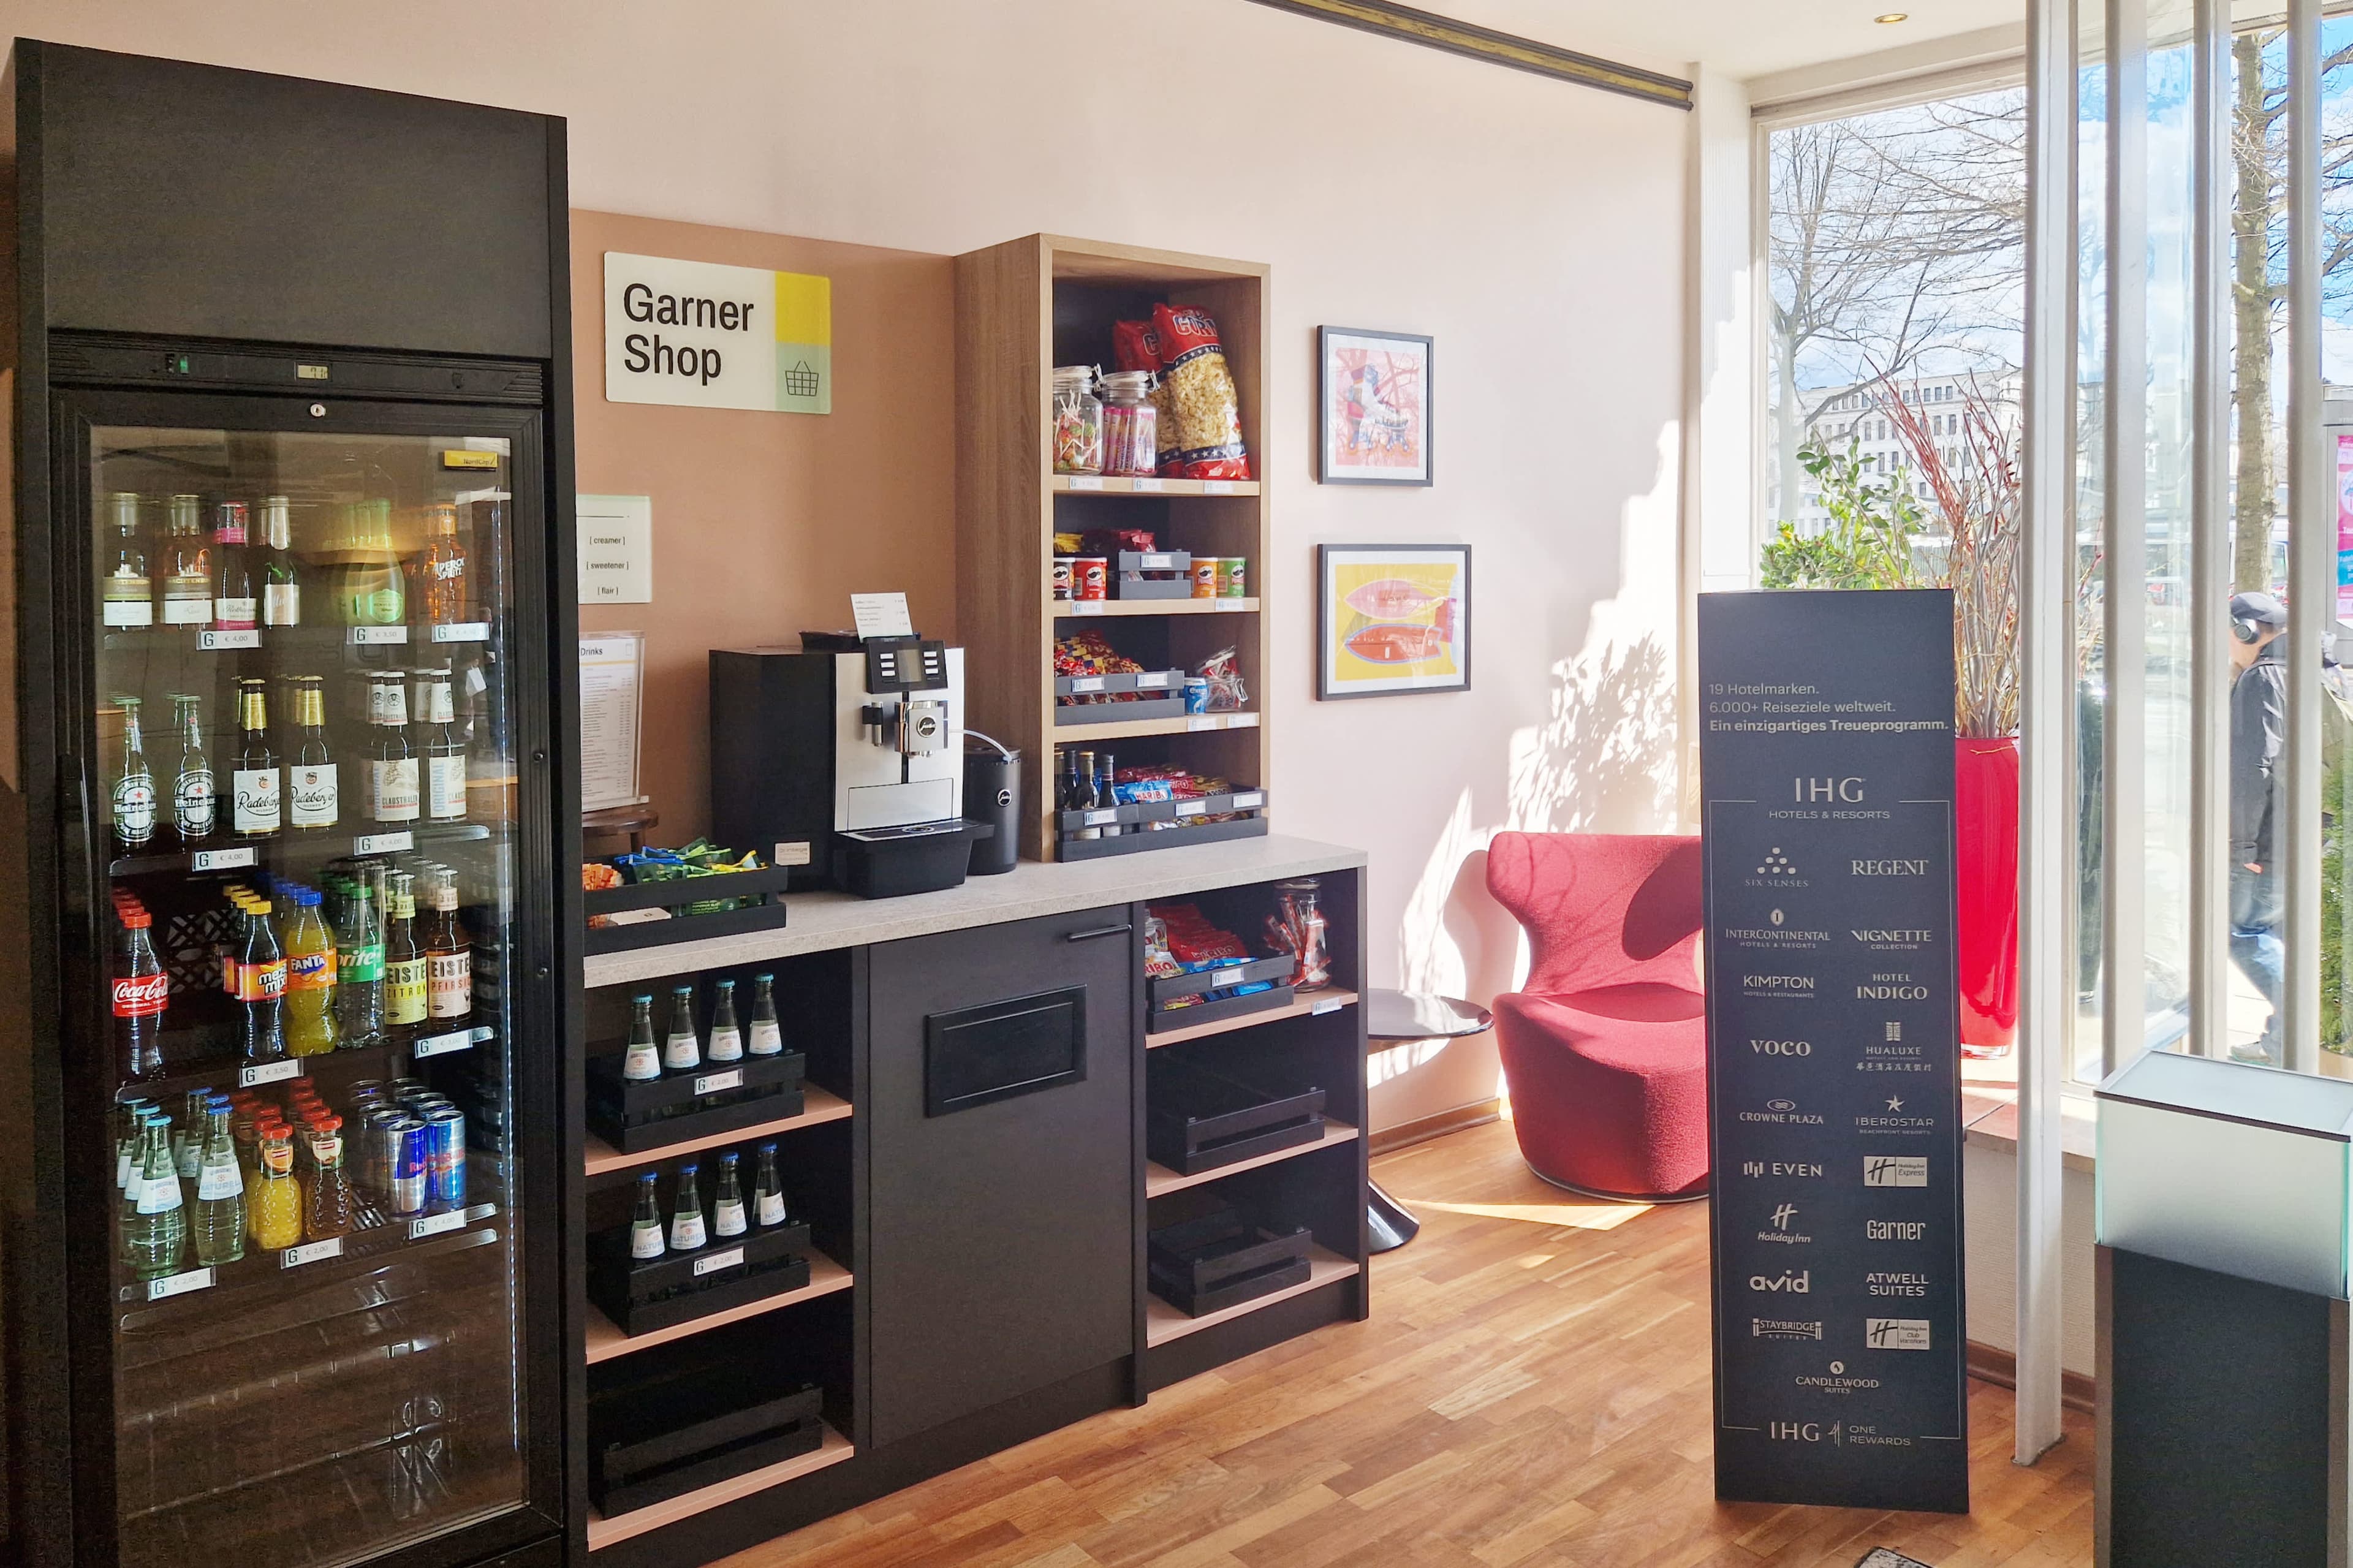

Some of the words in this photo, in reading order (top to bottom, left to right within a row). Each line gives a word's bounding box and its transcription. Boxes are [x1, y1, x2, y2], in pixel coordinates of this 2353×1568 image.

[624, 283, 754, 331] Garner
[624, 334, 721, 386] Shop
[357, 628, 366, 642] G
[438, 626, 447, 639] G
[204, 633, 214, 647] G
[580, 647, 603, 656] Drinks
[1708, 684, 1723, 695] 19
[1728, 683, 1819, 695] Hotelmarken.
[1709, 702, 1759, 713] 6.000+
[1763, 701, 1830, 713] Reiseziele
[1834, 700, 1896, 713] weltweit.
[1710, 720, 1731, 731] Ein
[1734, 719, 1827, 733] einzigartiges
[1830, 719, 1949, 733] Treueprogramm.
[1795, 777, 1864, 803] IHG
[1770, 811, 1818, 819] HOTELS
[1822, 811, 1829, 819] &
[1833, 811, 1890, 819] RESORTS
[362, 838, 371, 851] G
[199, 854, 209, 868] G
[1851, 860, 1929, 876] REGENT
[1851, 930, 1932, 942] VIGNETTE
[291, 955, 325, 970] FANTA
[338, 950, 373, 966] prite
[1144, 962, 1174, 974] RIBO
[1743, 975, 1814, 990] KIMPTON
[1873, 974, 1912, 982] HOTEL
[1856, 987, 1928, 1000] INDIGO
[420, 1040, 429, 1053] G
[1866, 1046, 1922, 1055] HUALUXE
[246, 1069, 256, 1083] G
[698, 1079, 705, 1091] G
[1739, 1112, 1785, 1123] CROWNE
[1789, 1115, 1824, 1124] PLAZA
[1855, 1117, 1934, 1127] IBEROSTAR
[1772, 1163, 1822, 1177] EVEN
[416, 1221, 425, 1234] G
[1866, 1219, 1926, 1240] Garner
[1757, 1231, 1794, 1244] Holiday
[1795, 1233, 1811, 1243] Inn
[289, 1249, 298, 1263] G
[696, 1260, 704, 1273] G
[1749, 1270, 1809, 1293] avid
[1866, 1273, 1929, 1284] ATWELL
[154, 1281, 165, 1295] G
[1869, 1285, 1925, 1297] SUITES
[1760, 1320, 1815, 1331] STAYBRIDGE
[1795, 1376, 1879, 1388] CANDLEWOOD
[1771, 1422, 1820, 1441] IHG
[1849, 1425, 1876, 1434] ONE
[1849, 1436, 1911, 1445] REWARDS
